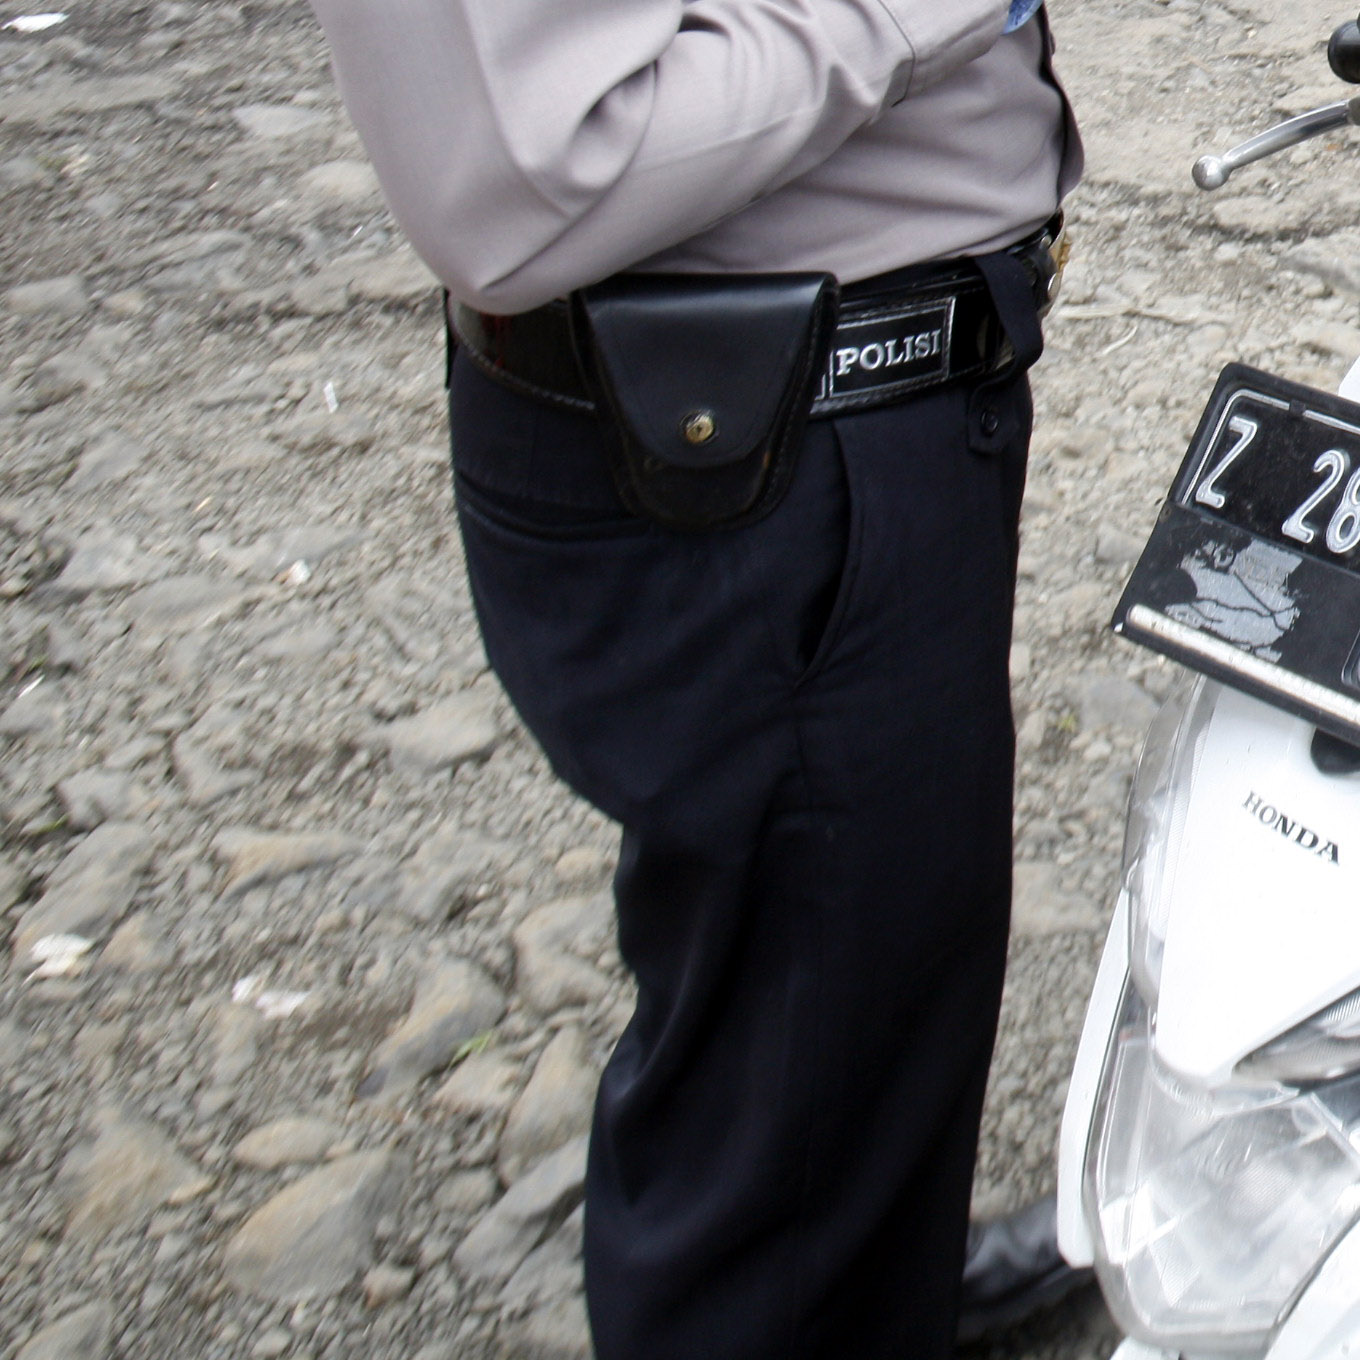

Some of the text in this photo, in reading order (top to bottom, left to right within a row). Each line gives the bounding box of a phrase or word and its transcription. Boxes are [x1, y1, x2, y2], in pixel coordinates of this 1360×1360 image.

[836, 328, 942, 377] POLISI
[1196, 416, 1258, 508] Z
[1242, 790, 1342, 866] HONDA
